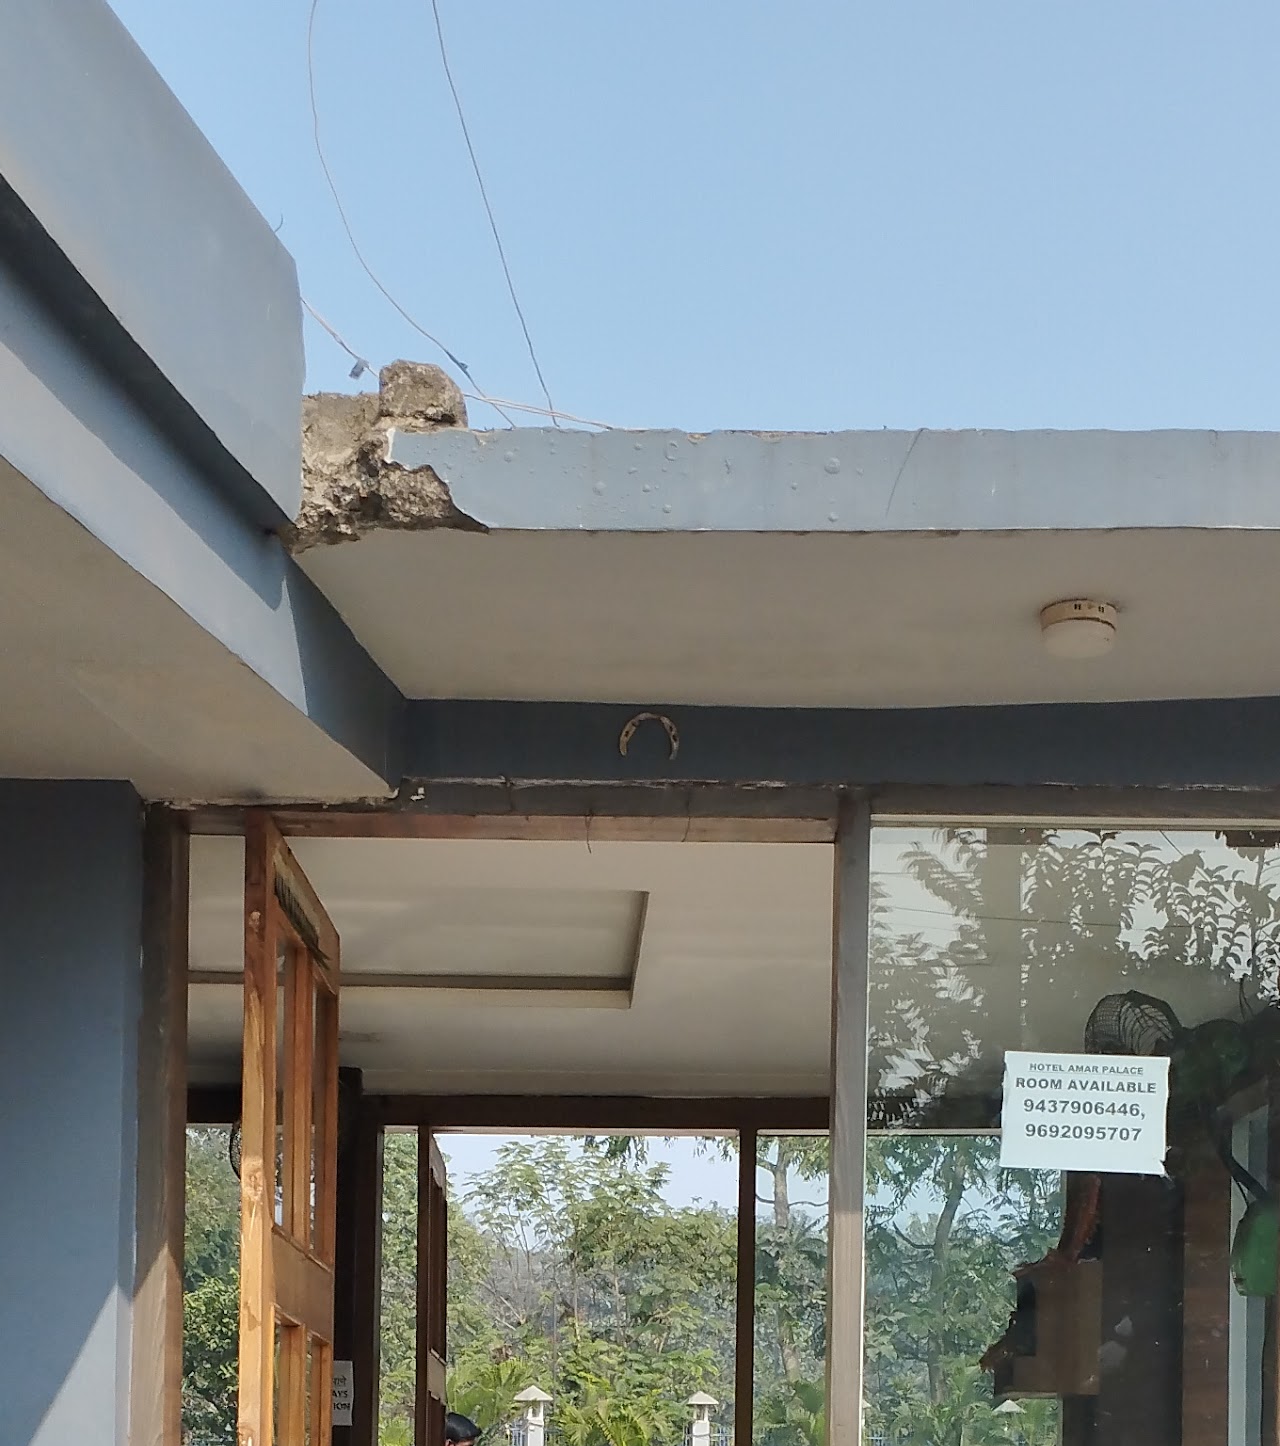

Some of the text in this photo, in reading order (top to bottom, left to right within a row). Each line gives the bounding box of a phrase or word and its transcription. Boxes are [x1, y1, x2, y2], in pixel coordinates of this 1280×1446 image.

[1029, 1063, 1144, 1075] HOTEL AMAR PALACE
[1015, 1077, 1157, 1093] ROOM AVAILABLE
[1023, 1098, 1146, 1120] 9437906446,
[1025, 1123, 1143, 1141] 9692095707
